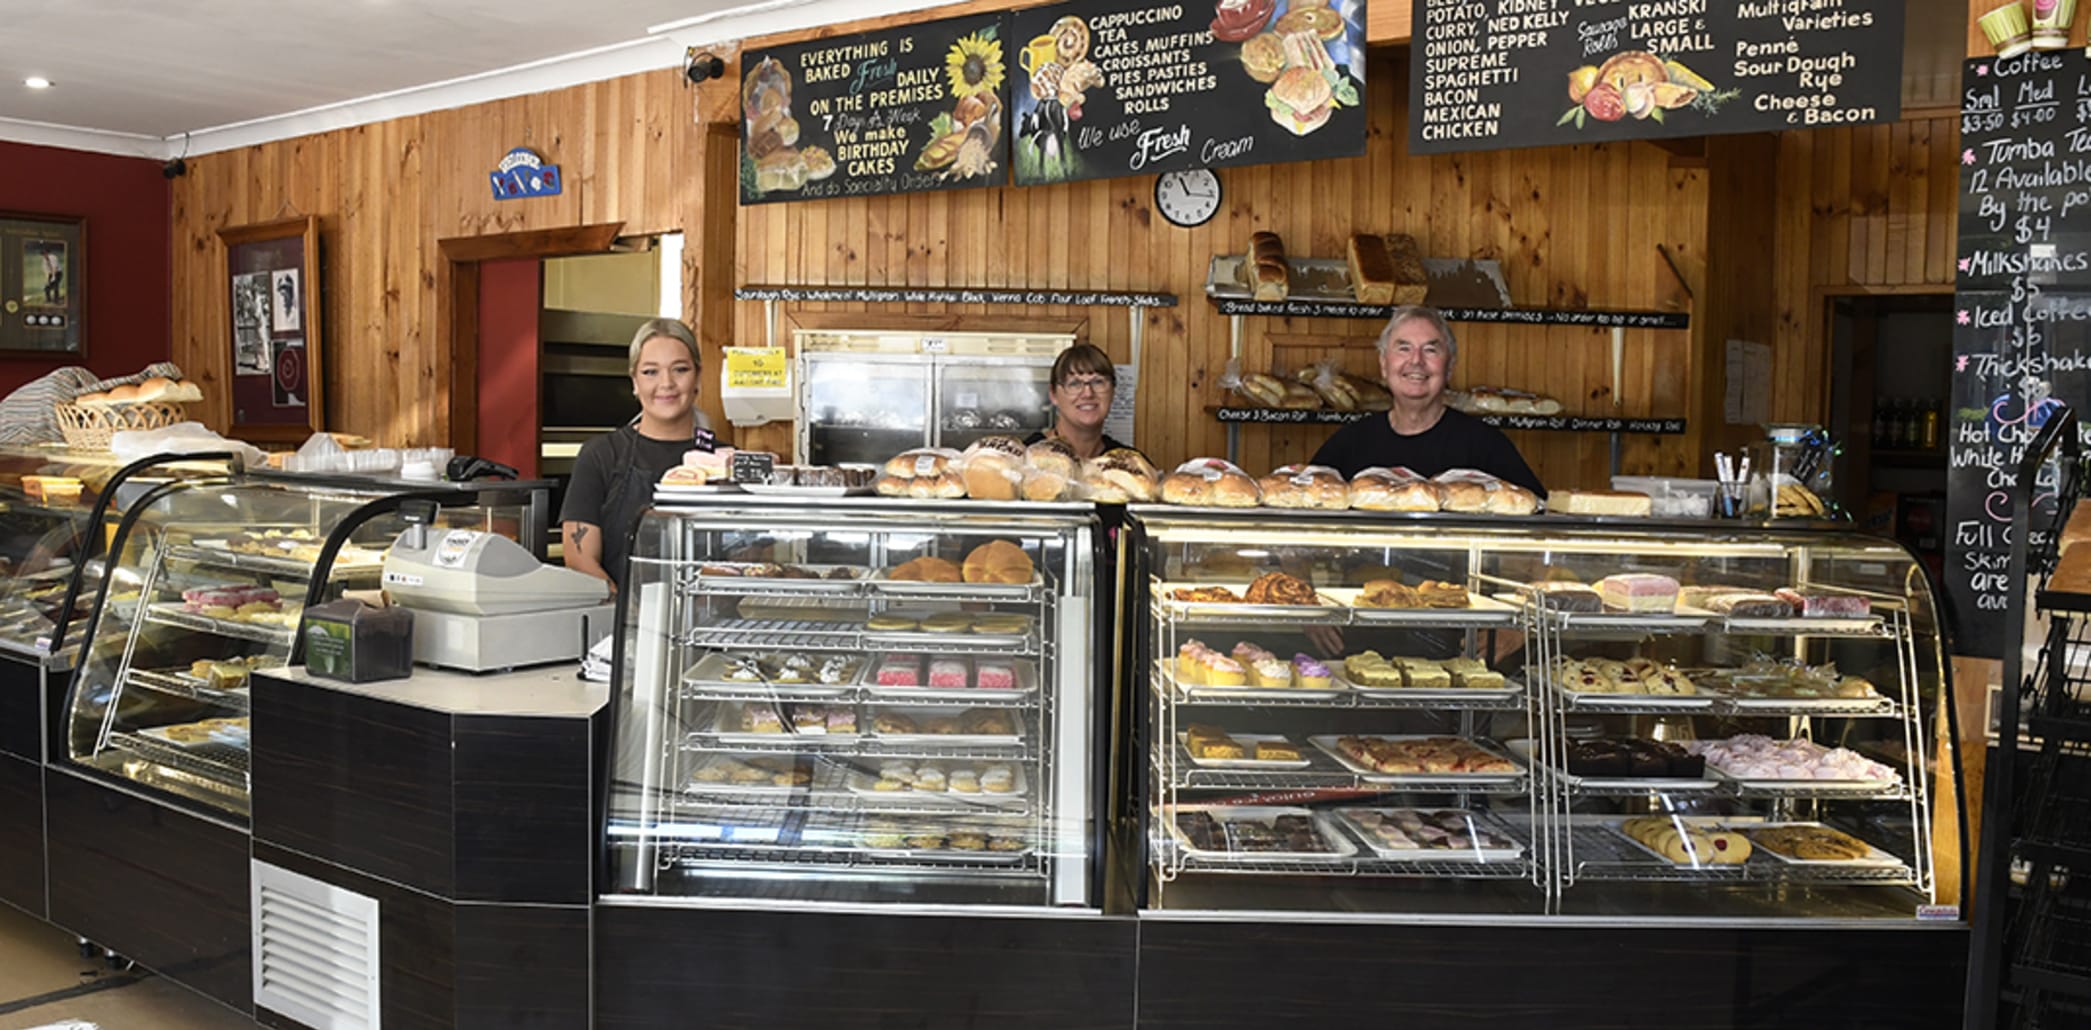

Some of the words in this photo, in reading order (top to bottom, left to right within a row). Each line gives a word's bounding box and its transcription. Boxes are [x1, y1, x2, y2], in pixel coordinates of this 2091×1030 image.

[1089, 4, 1183, 30] CAPPUCCINO
[1426, 2, 1489, 24] POTATO,
[1628, 0, 1707, 20] KRANSKI
[1782, 11, 1874, 31] Varieties
[1098, 27, 1128, 44] TEA
[1426, 21, 1480, 41] CURRY,
[1487, 16, 1520, 33] NED
[1523, 10, 1570, 30] KELLY
[1631, 18, 1689, 39] LARGE
[1145, 30, 1214, 52] MUFFINS
[1425, 38, 1481, 57] ONION,
[1487, 32, 1548, 51] PEPPER
[1646, 33, 1715, 54] SMALL
[800, 40, 889, 68] EVERYTHING
[900, 37, 914, 53] IS
[1102, 49, 1191, 71] CROISSANTS
[1425, 52, 1508, 74] SUPREME
[1147, 62, 1208, 80] PASTIES
[1733, 60, 1782, 77] Sour
[1786, 52, 1856, 73] Dough
[1993, 53, 2064, 77] Coffee
[805, 63, 851, 84] BAKED
[849, 58, 897, 95] Fresh
[897, 67, 940, 87] DAILY
[1115, 75, 1217, 100] SANDWICHES
[1424, 67, 1519, 90] SPAGHETTI
[1799, 71, 1843, 92] Rye
[810, 98, 830, 116] ON
[835, 93, 864, 111] THE
[869, 83, 944, 109] PREMISES
[1424, 88, 1479, 107] BACON
[1754, 93, 1836, 111] Cheese
[2017, 79, 2055, 103] Med
[1124, 97, 1170, 115] ROLLS
[1423, 103, 1501, 123] MEXICAN
[1804, 107, 1875, 125] Bacon
[822, 114, 833, 131] 7
[1422, 120, 1499, 141] CHICKEN
[834, 129, 857, 145] We
[865, 124, 907, 141] make
[1078, 126, 1104, 149] We
[1108, 119, 1141, 141] use
[1129, 124, 1191, 170] Fresh
[1200, 136, 1254, 164] Cream
[837, 139, 910, 161] BIRTHDAY
[1981, 138, 2055, 165] Tumba
[847, 157, 895, 177] CAKES
[1978, 194, 2007, 232] By
[2017, 190, 2053, 213] the
[2015, 215, 2050, 244] $4
[1974, 303, 2015, 328] Iced
[1959, 421, 1991, 443] Hot
[1955, 521, 1992, 548] Full
[1970, 571, 2008, 591] are
